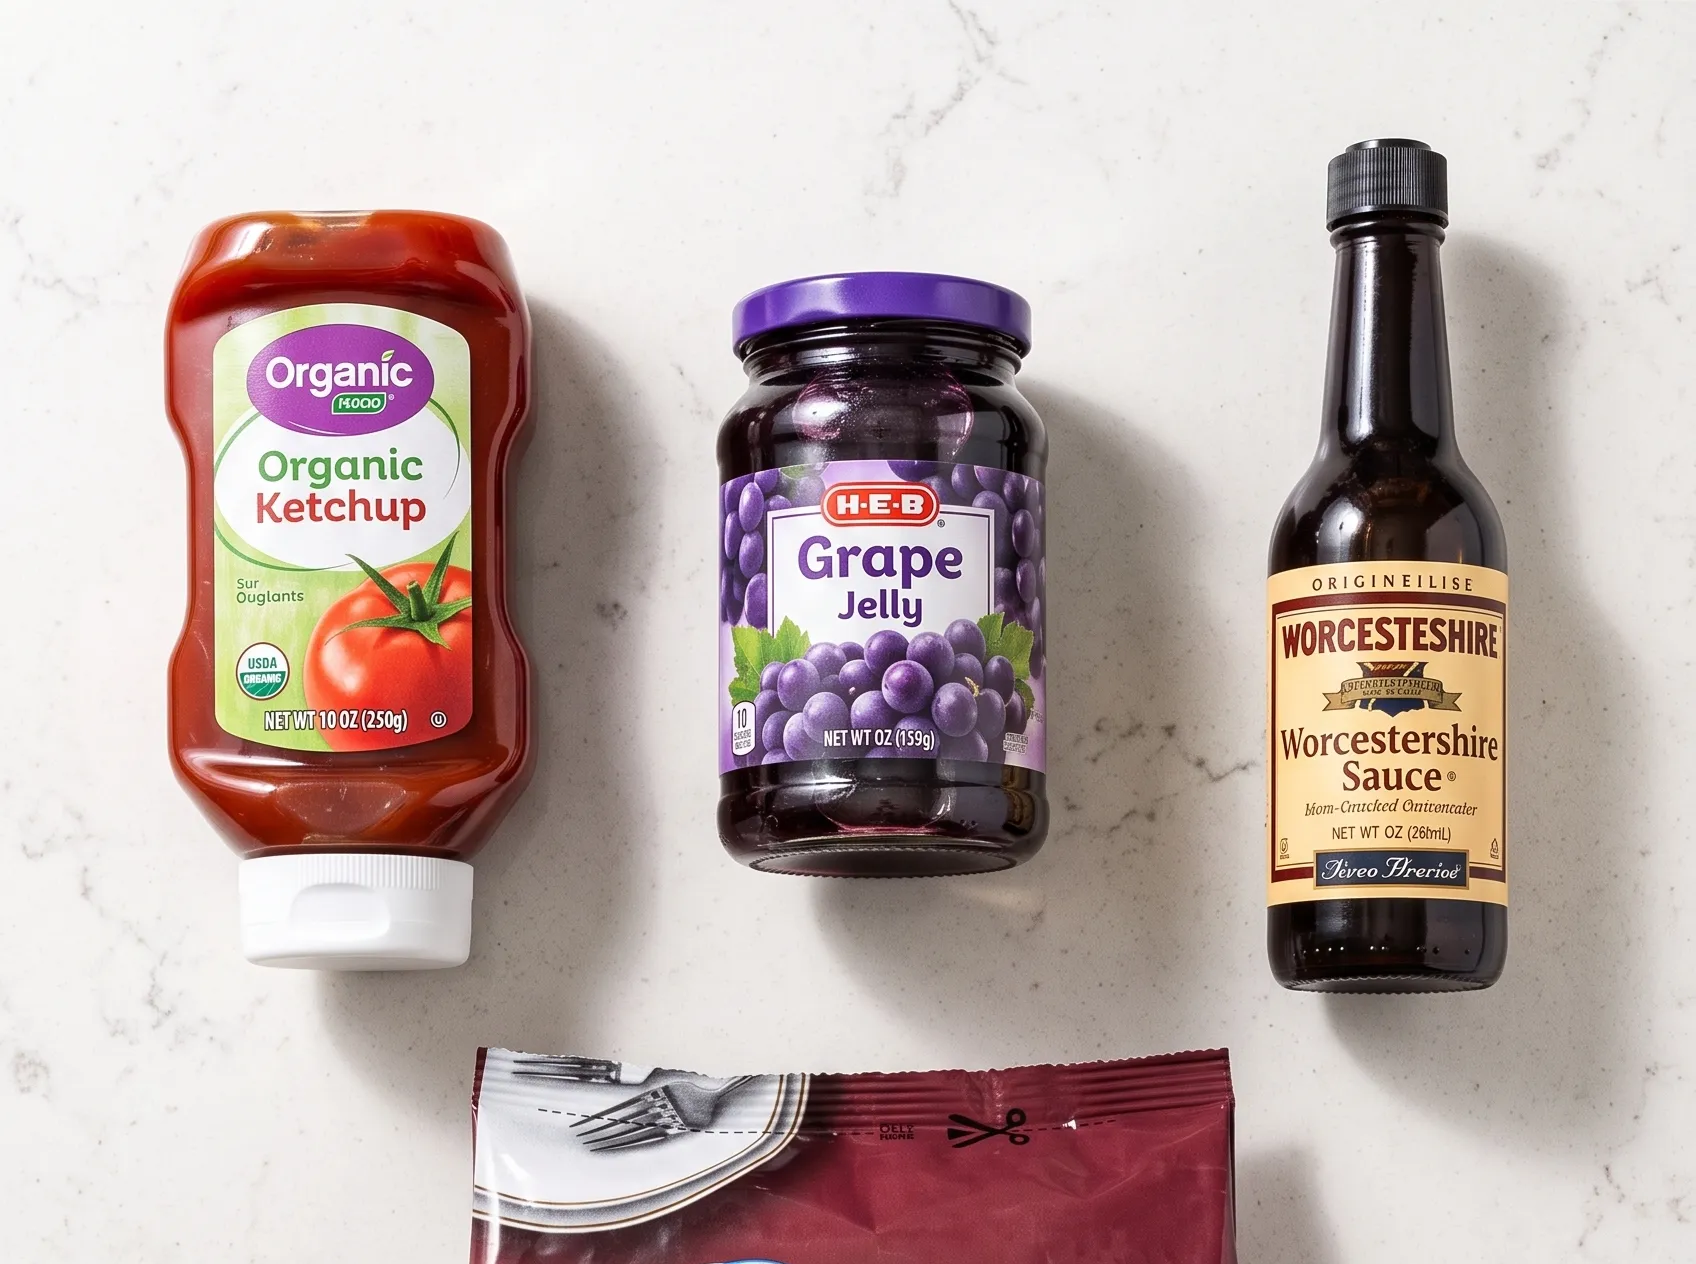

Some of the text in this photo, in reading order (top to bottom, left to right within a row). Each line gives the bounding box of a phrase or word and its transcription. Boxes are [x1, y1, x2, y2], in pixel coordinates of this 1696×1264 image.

[266, 351, 413, 398] Organic
[258, 448, 424, 489] Organic
[256, 489, 427, 531] Ketchup
[798, 535, 963, 589] Grape
[236, 578, 259, 589] Sur
[1312, 574, 1473, 591] ORIGINEILISE
[236, 590, 304, 606] Ouglants
[837, 589, 923, 627] Jelly
[1282, 617, 1499, 659] WORCESTESHIRE
[248, 657, 277, 669] USDA
[264, 709, 408, 733] NET WT 10 OZ (250g)
[737, 708, 747, 728] 10
[824, 729, 935, 751] NET WT OZ (159g)
[1281, 724, 1499, 760] Worcestershire
[1342, 760, 1442, 791] Sauce
[1332, 827, 1355, 840] NET
[1360, 826, 1379, 839] WT
[1384, 826, 1403, 839] OZ
